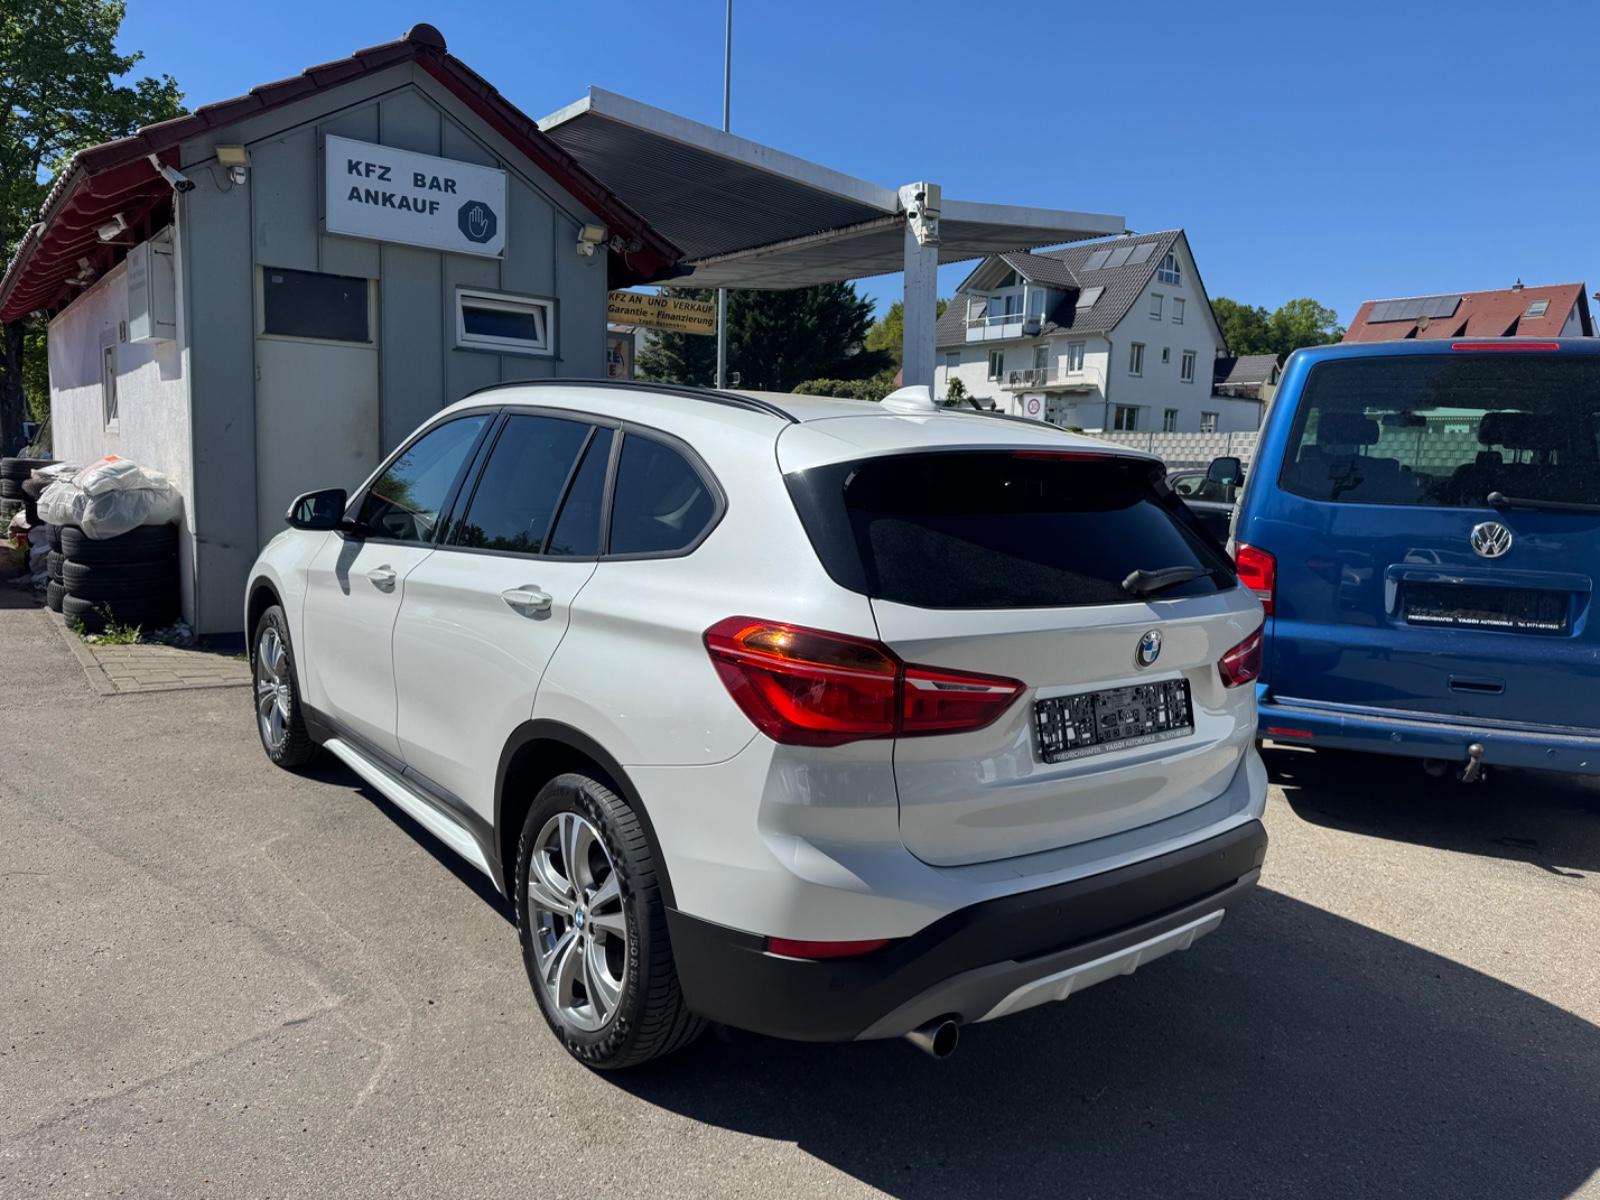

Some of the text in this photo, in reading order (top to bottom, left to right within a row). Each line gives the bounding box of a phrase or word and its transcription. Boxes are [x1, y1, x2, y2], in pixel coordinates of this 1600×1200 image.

[347, 159, 457, 194] KFZ BAR
[347, 186, 440, 215] ANKAUF
[607, 304, 648, 317] Garantie
[656, 310, 714, 327] Finanzierung
[608, 292, 714, 313] KFZ AN UND VERKAUF
